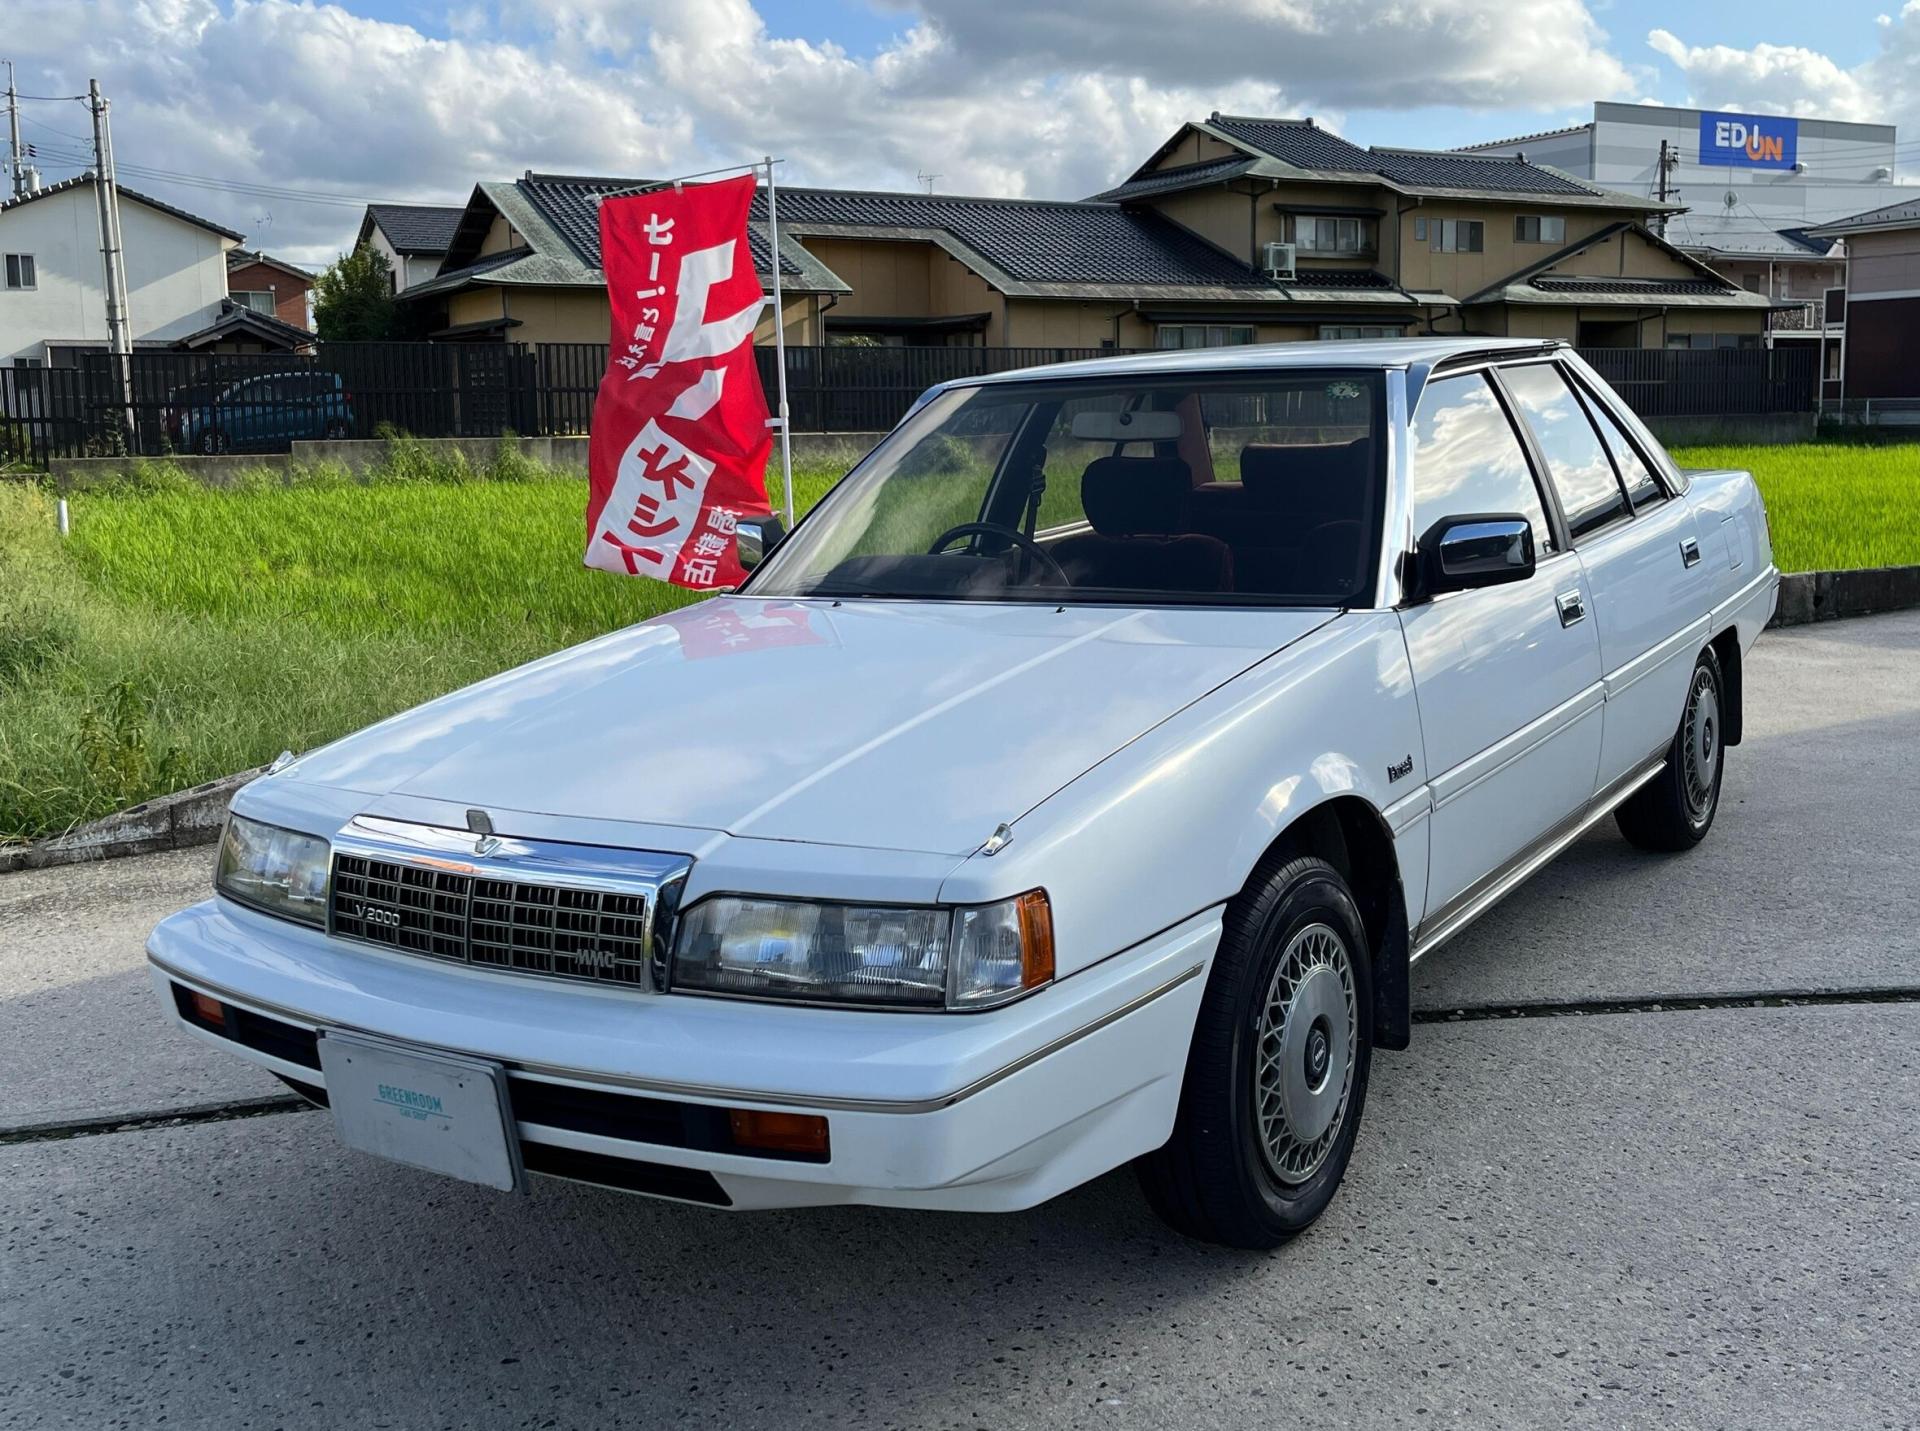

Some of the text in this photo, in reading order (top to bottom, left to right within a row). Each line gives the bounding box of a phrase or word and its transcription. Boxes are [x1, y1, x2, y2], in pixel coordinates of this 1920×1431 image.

[1715, 120, 1784, 162] EDION
[574, 948, 616, 968] MMC
[379, 1084, 442, 1111] GREENROOM
